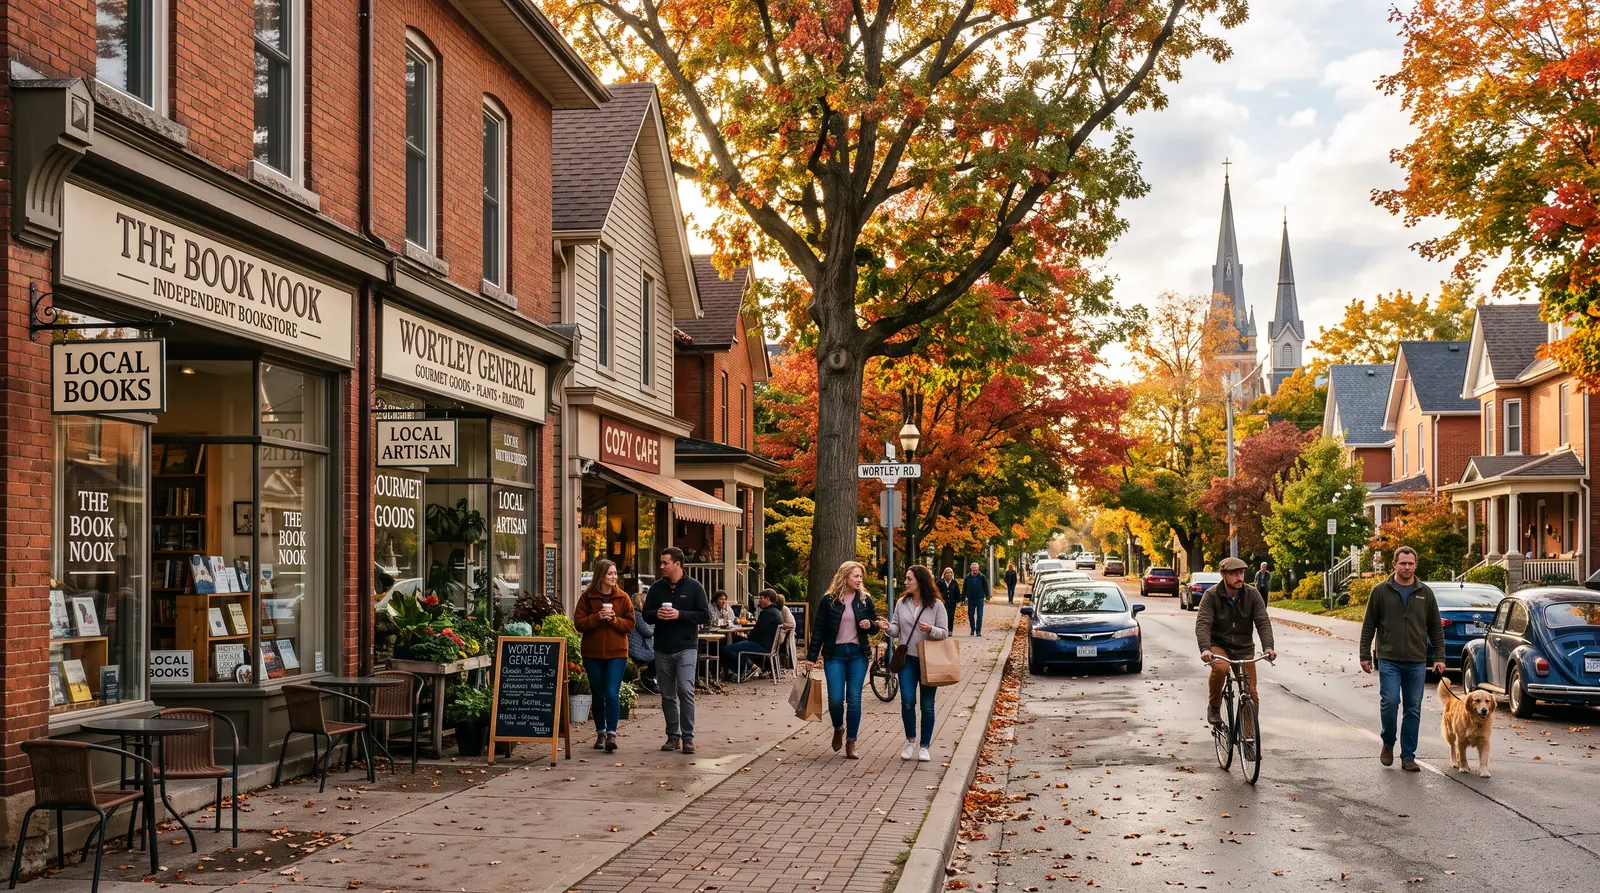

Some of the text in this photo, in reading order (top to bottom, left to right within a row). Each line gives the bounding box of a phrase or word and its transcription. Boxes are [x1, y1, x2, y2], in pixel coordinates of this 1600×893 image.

[116, 212, 322, 324] THE BOOK NOOK
[153, 277, 298, 339] INDEPENDENT BOOKSTORE
[64, 350, 150, 375] LOCAL
[399, 317, 536, 396] WORTLEY GENERAL
[63, 378, 151, 403] BOOKS
[415, 364, 448, 387] GOURMET
[449, 376, 471, 394] GOODS
[476, 383, 498, 401] PLANTS
[390, 426, 443, 442] LOCAL
[381, 444, 451, 460] ARTISAN
[605, 426, 659, 466] COZY CAFE
[862, 466, 917, 477] WORTLEY RD.
[374, 474, 422, 499] OURMET
[78, 490, 109, 513] THE
[498, 491, 525, 512] LOCAL
[69, 515, 115, 538] BOOK
[283, 510, 303, 528] THE
[374, 504, 415, 530] GOODS
[494, 515, 528, 535] ARTISAN
[278, 529, 307, 547] BOOK
[69, 541, 116, 563] NOOK
[278, 549, 307, 566] NOOK
[507, 644, 552, 655] WORTLEY
[508, 655, 549, 666] GENERAL
